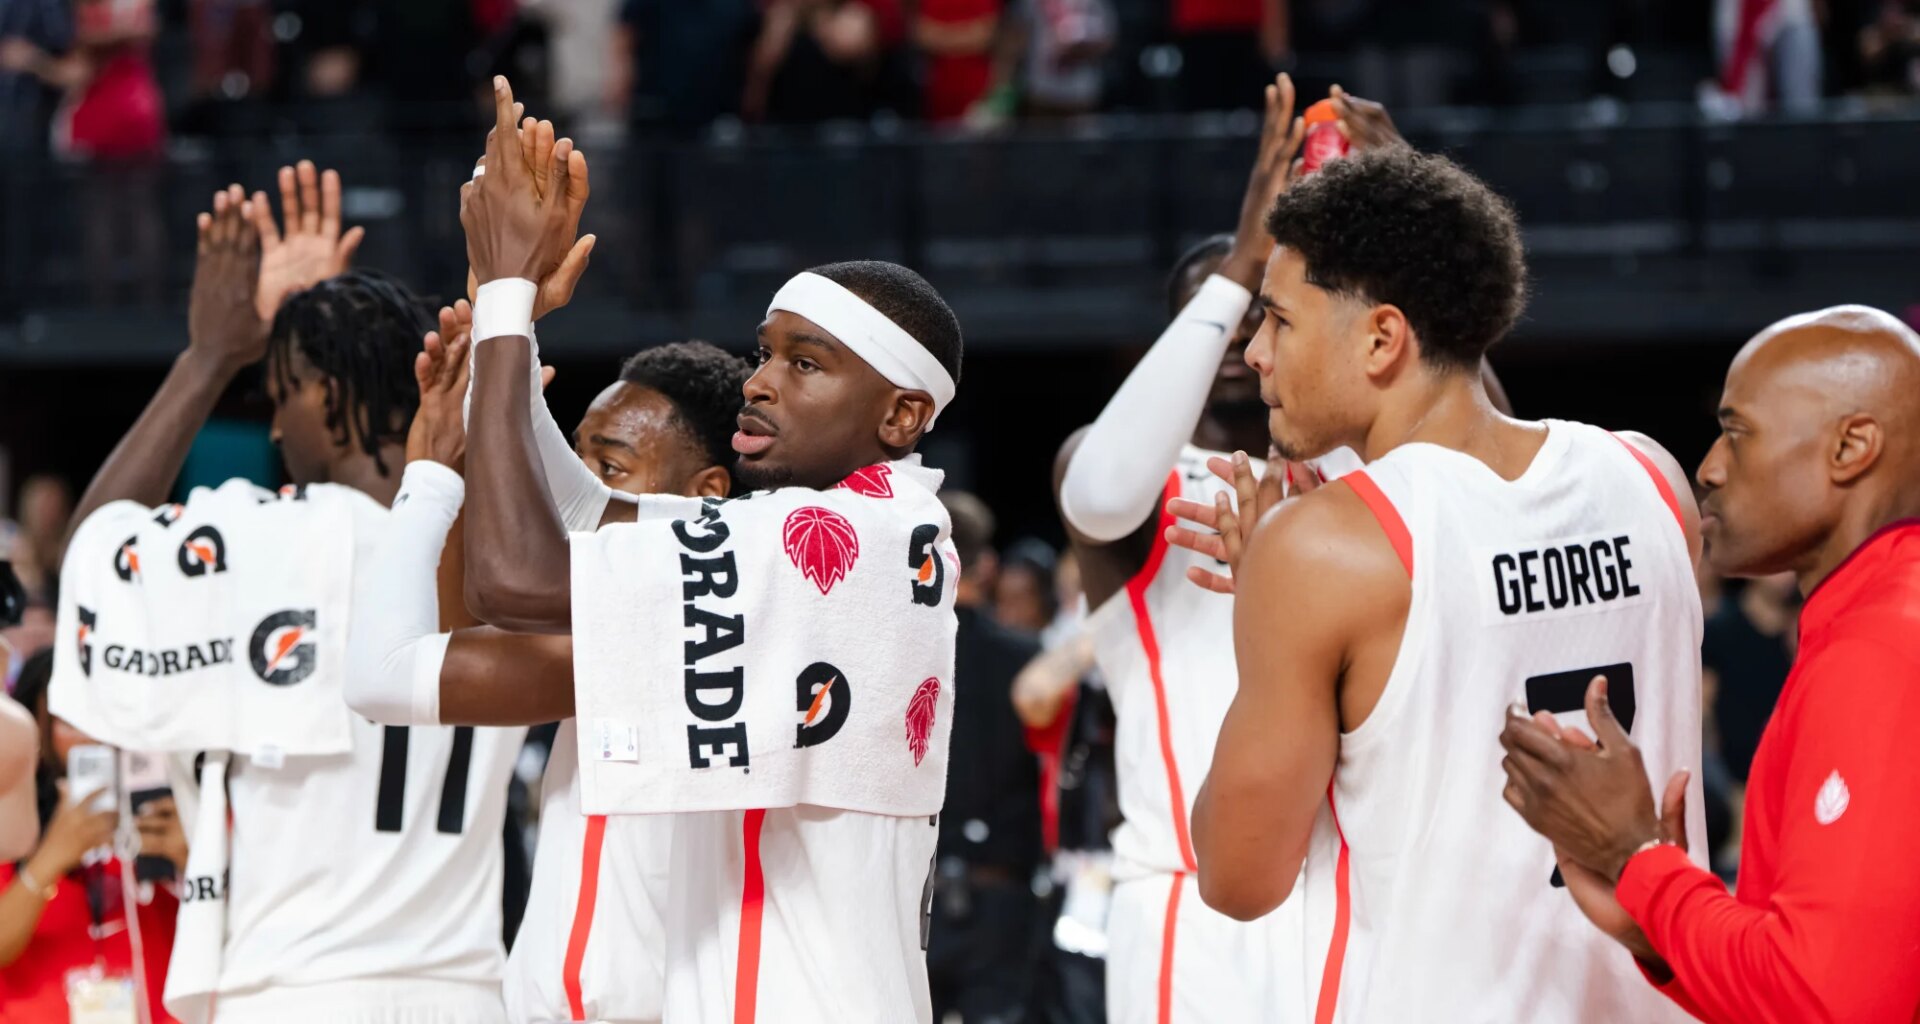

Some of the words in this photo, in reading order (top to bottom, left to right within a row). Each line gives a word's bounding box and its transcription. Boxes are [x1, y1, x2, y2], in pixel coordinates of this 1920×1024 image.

[1492, 535, 1641, 616] GEORGE
[249, 609, 316, 686] G
[671, 491, 750, 769] ORADE
[796, 661, 852, 748] G
